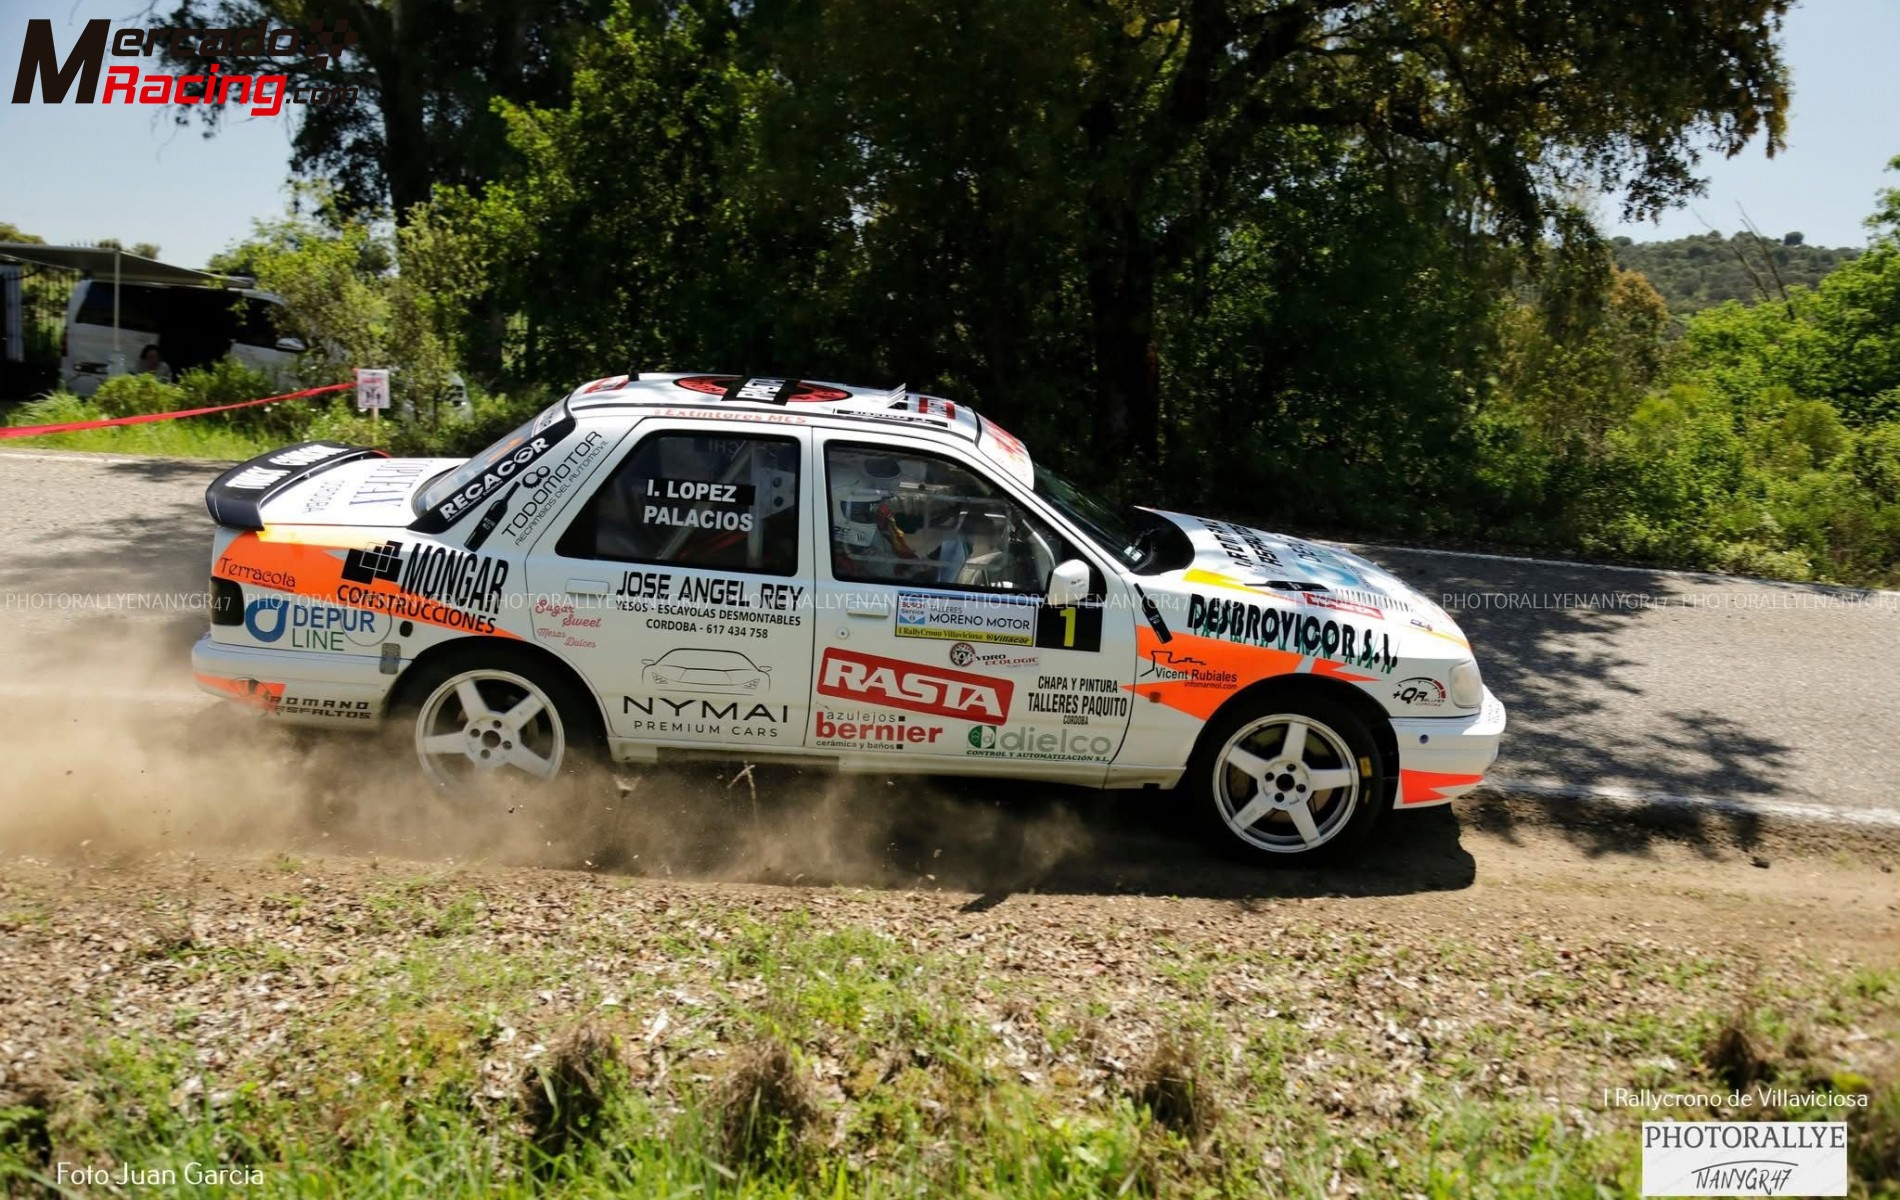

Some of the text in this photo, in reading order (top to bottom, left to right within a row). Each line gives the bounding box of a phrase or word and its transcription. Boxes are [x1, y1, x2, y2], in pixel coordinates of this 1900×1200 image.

[664, 409, 762, 421] Extintores
[439, 437, 550, 521] RECACOR
[501, 431, 602, 538] TODOMOTOR
[646, 479, 737, 503] I. LOPEZ
[515, 499, 557, 546] RECAMBIOS
[556, 481, 573, 501] DEL
[643, 505, 754, 532] PALACIOS
[401, 543, 509, 614] MONGAR
[616, 571, 804, 611] JOSE ANGEL REY
[293, 604, 375, 633] DEPUR
[337, 584, 496, 634] CONSTRUCCIONES
[535, 600, 574, 617] Sugar
[616, 601, 648, 613] YESOS
[657, 604, 716, 619] ESCAYOLAS
[719, 610, 801, 626] DESMONTABLES
[930, 605, 963, 614] TALLERES
[562, 614, 602, 628] Sweet
[646, 619, 696, 632] CORDOBA
[706, 624, 724, 635] 617
[727, 627, 746, 637] 434
[749, 628, 768, 638] 758
[929, 613, 1030, 630] MORENO MOTOR
[1060, 606, 1076, 647] 1
[292, 629, 345, 651] LINE
[564, 637, 597, 648] Dulces
[985, 657, 1039, 666] ECOLOGIC
[1037, 675, 1118, 694] CHAPA Y PINTURA
[1155, 667, 1237, 682] Vicent Rubiales
[823, 657, 1004, 718] RASTA
[1184, 682, 1238, 690] infomarmol.com
[270, 695, 369, 710] ROMANO
[623, 695, 788, 723] NYMAI
[1028, 692, 1128, 717] TALLERES PAQUITO
[816, 711, 943, 743] bernier
[826, 710, 896, 725] azulejos
[1063, 714, 1088, 725] CORDOBA
[634, 720, 778, 738] PREMIUM CARS
[1000, 726, 1112, 755] dielco
[966, 749, 1007, 758] CONTROL
[1015, 752, 1095, 761] AUTOMATIZACIÓN
